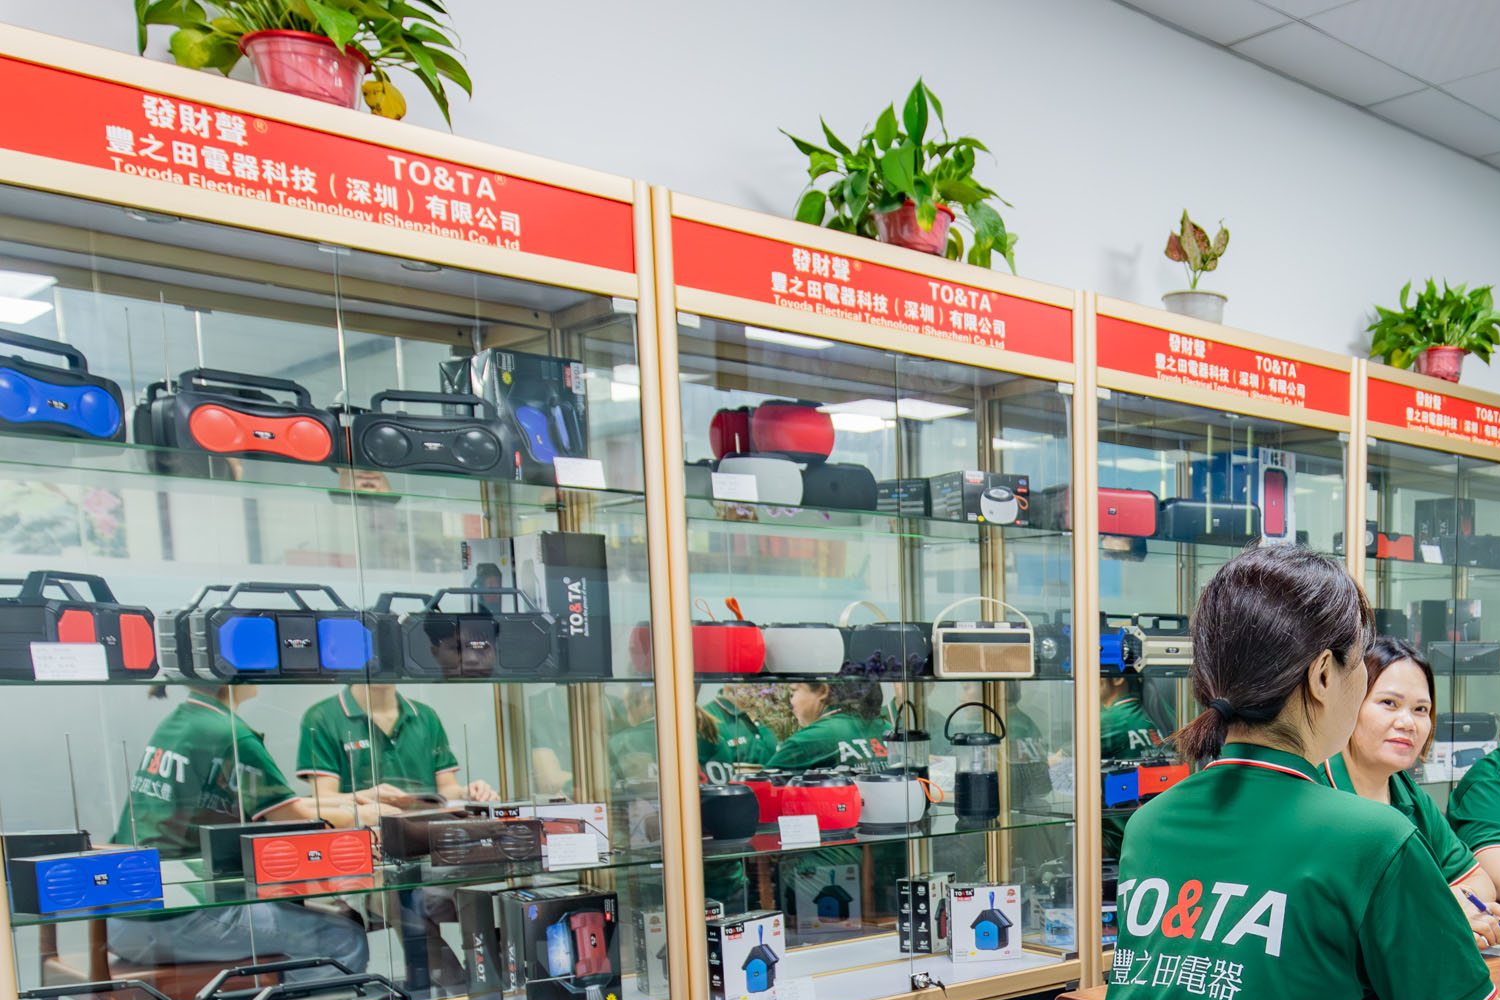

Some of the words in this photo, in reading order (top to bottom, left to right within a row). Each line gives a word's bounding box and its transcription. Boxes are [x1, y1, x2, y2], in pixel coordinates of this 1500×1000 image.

[142, 95, 248, 147] 發財聲
[189, 173, 271, 201] Electrical
[387, 155, 497, 202] TO&TA
[792, 248, 850, 282] 發財聲
[928, 281, 992, 312] TO&TA
[1255, 355, 1297, 378] TO&TA
[568, 580, 584, 637] TO&TA
[1117, 878, 1288, 957] TO&TA
